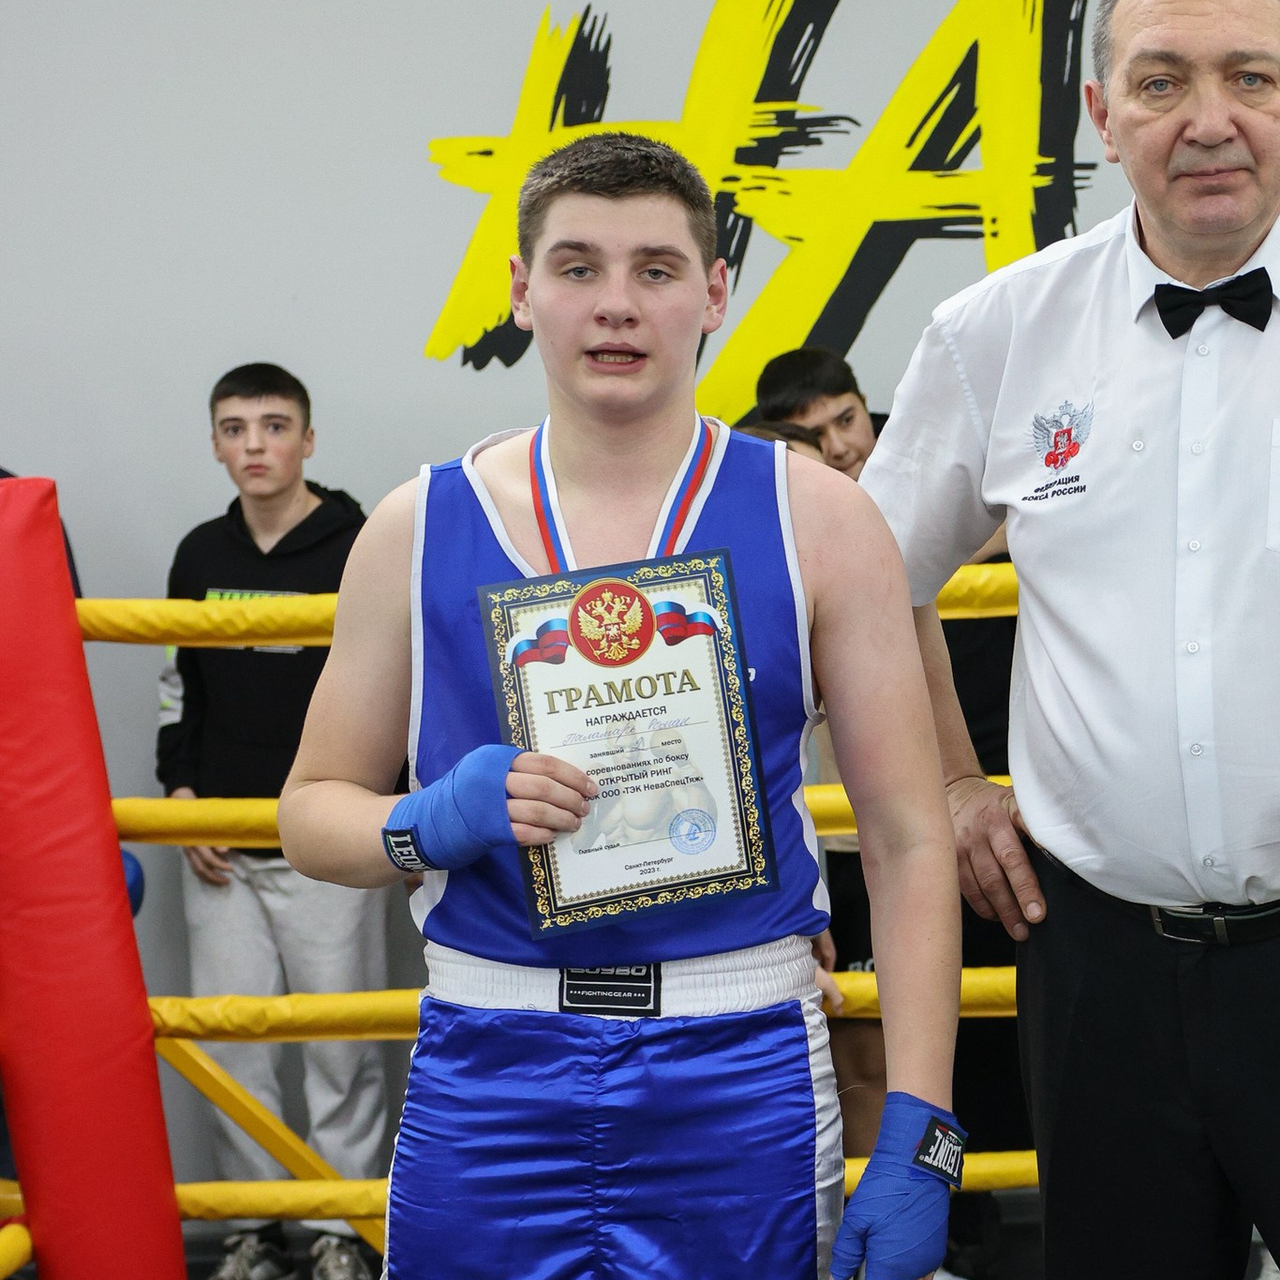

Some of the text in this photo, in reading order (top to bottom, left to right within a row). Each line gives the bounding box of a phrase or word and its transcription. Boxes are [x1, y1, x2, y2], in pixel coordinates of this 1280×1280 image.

[1021, 484, 1087, 501] БОКСА РОССИИ
[1033, 474, 1080, 493] ФЕДЕРАЦИЯ
[544, 669, 701, 715] ГРАМОТА
[585, 705, 667, 727] НАГРАЖДАЕТСЯ
[589, 747, 625, 759] занявший
[661, 738, 682, 747] место
[586, 752, 690, 776] соревнованиях по боксу
[599, 766, 673, 786] ОТКРЫТЫЙ РИНГ
[601, 788, 621, 799] ООО
[388, 834, 435, 872] LEON
[578, 842, 621, 855] Главный судья
[624, 856, 674, 871] Санкт-Петербург
[639, 867, 656, 875] 2023
[923, 1128, 962, 1178] LEONE
